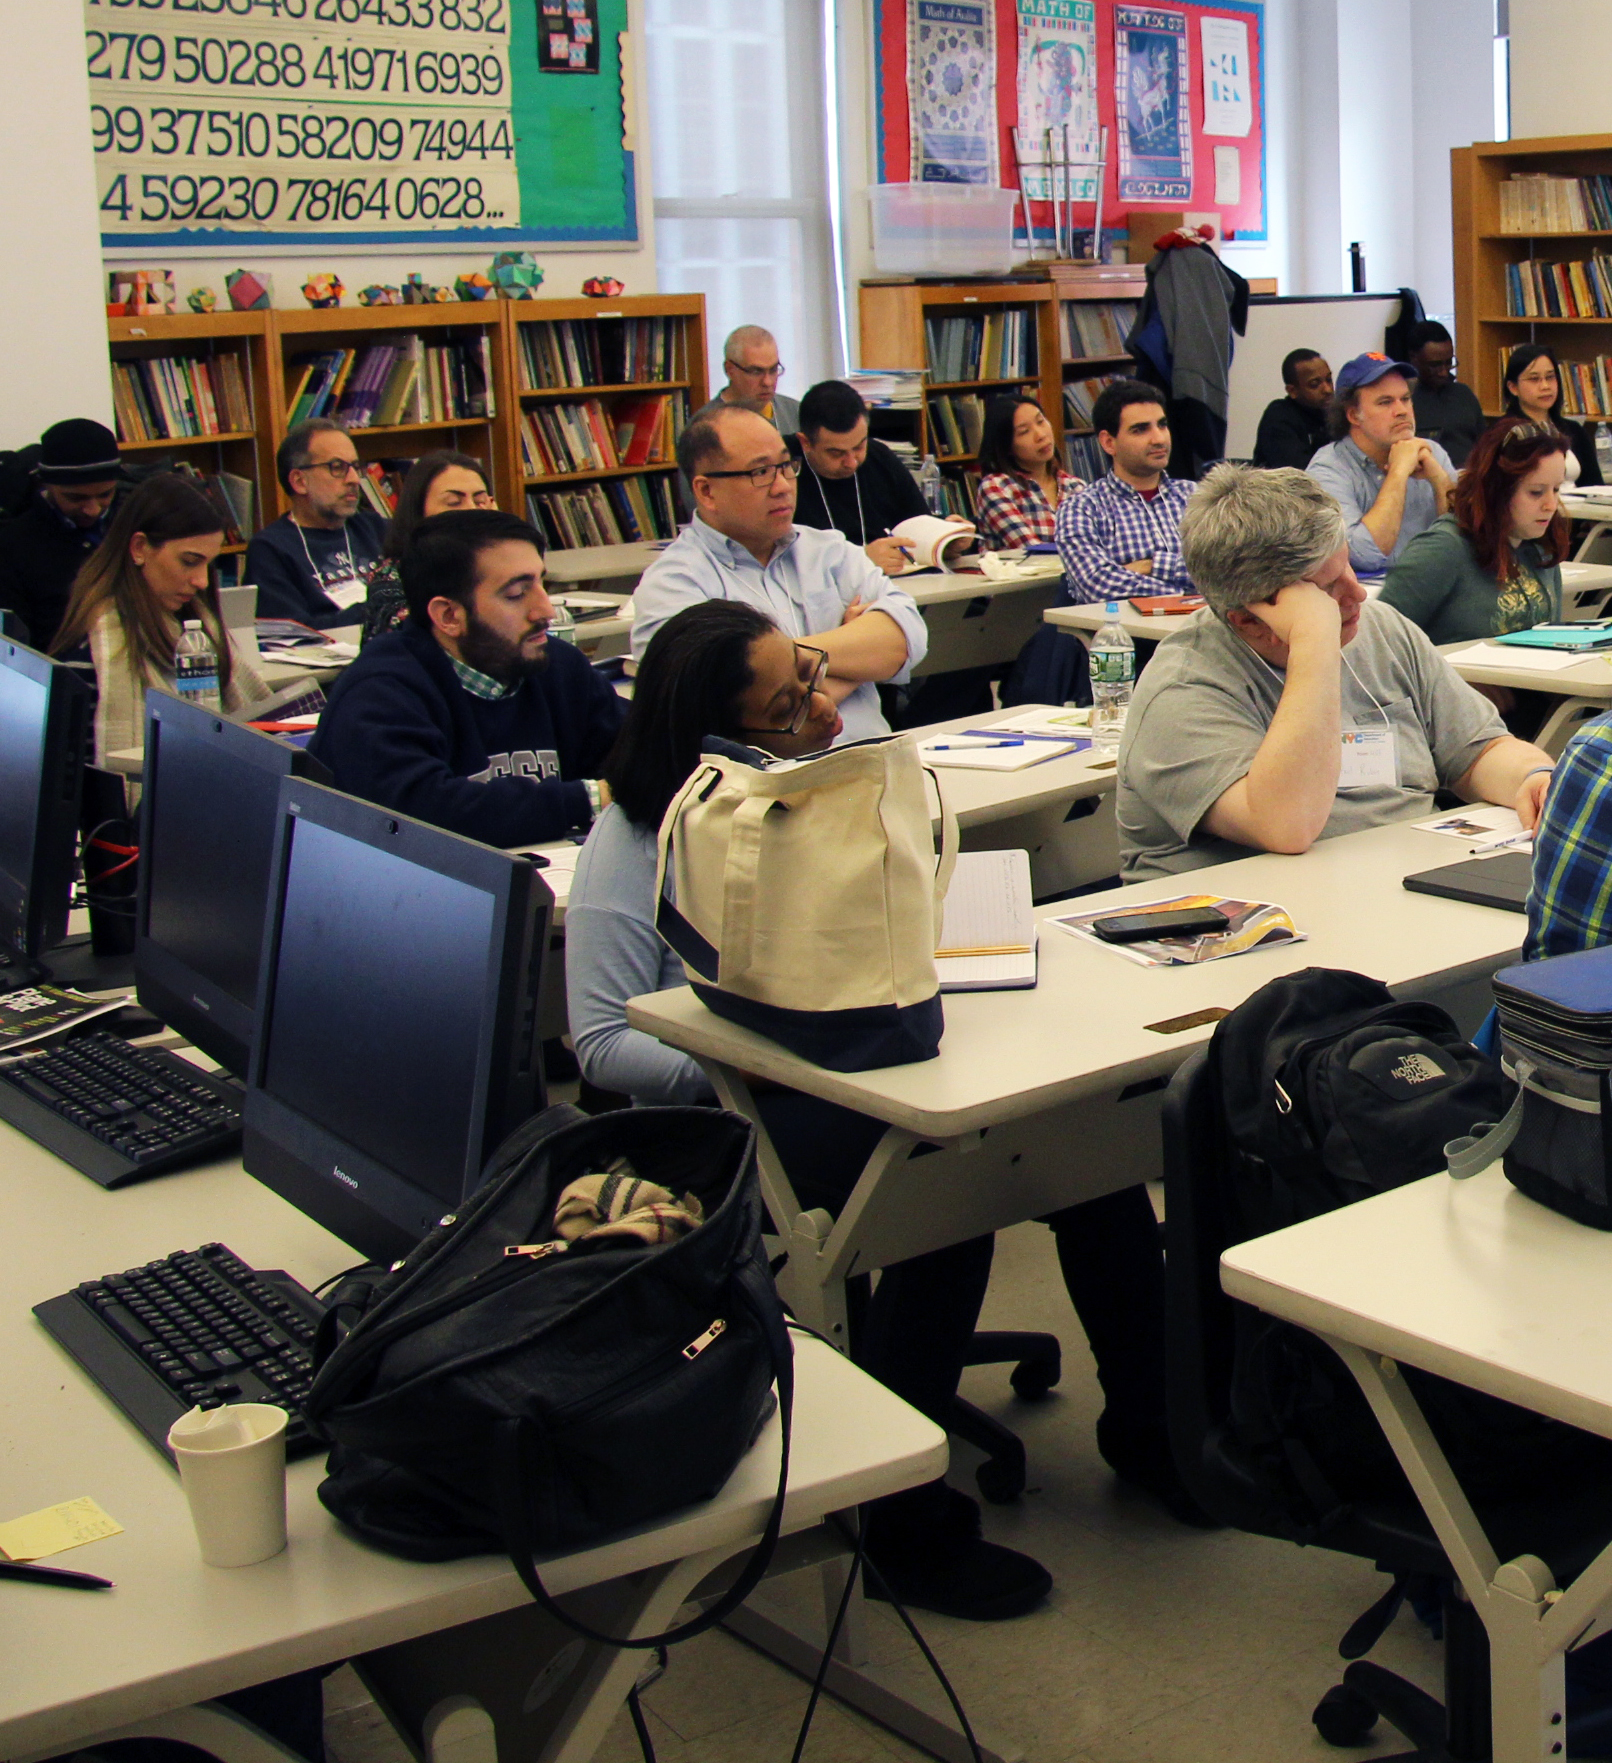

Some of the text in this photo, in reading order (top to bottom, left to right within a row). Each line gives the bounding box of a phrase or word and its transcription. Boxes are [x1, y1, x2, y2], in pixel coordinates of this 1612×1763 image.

[1021, 0, 1092, 19] MATH OF
[85, 30, 504, 96] 279 50288 41971 6939
[90, 104, 514, 161] 99 37510 58209 74944
[100, 174, 134, 221] 4
[140, 174, 280, 222] 59230
[286, 177, 390, 221] 78164
[1398, 1054, 1419, 1067] THE
[1391, 1064, 1427, 1080] NORTH
[1405, 1070, 1432, 1086] FACE
[333, 1165, 359, 1189] lenovo
